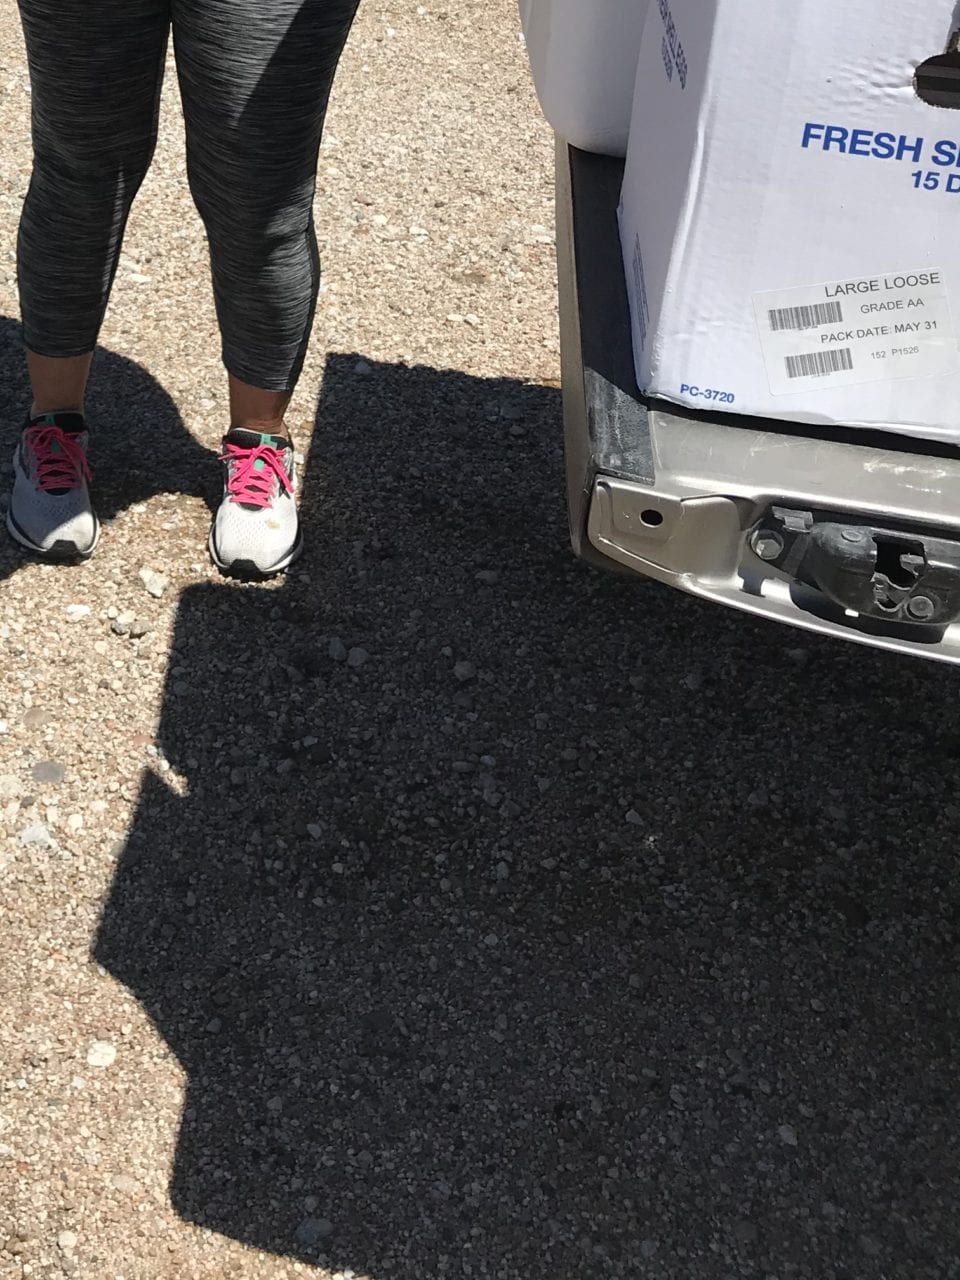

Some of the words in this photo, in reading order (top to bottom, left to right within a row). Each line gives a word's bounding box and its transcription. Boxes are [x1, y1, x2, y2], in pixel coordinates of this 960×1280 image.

[801, 122, 924, 163] FRESH
[931, 140, 960, 167] S
[911, 170, 940, 190] 15
[824, 279, 880, 298] LARGE
[884, 272, 941, 291] LOOSE
[860, 300, 904, 314] GRADE
[907, 297, 925, 309] AA
[820, 330, 855, 344] PACK
[894, 322, 921, 334] MAY
[924, 320, 938, 330] 31
[870, 350, 887, 360] 152
[680, 383, 735, 404] PC-3720
